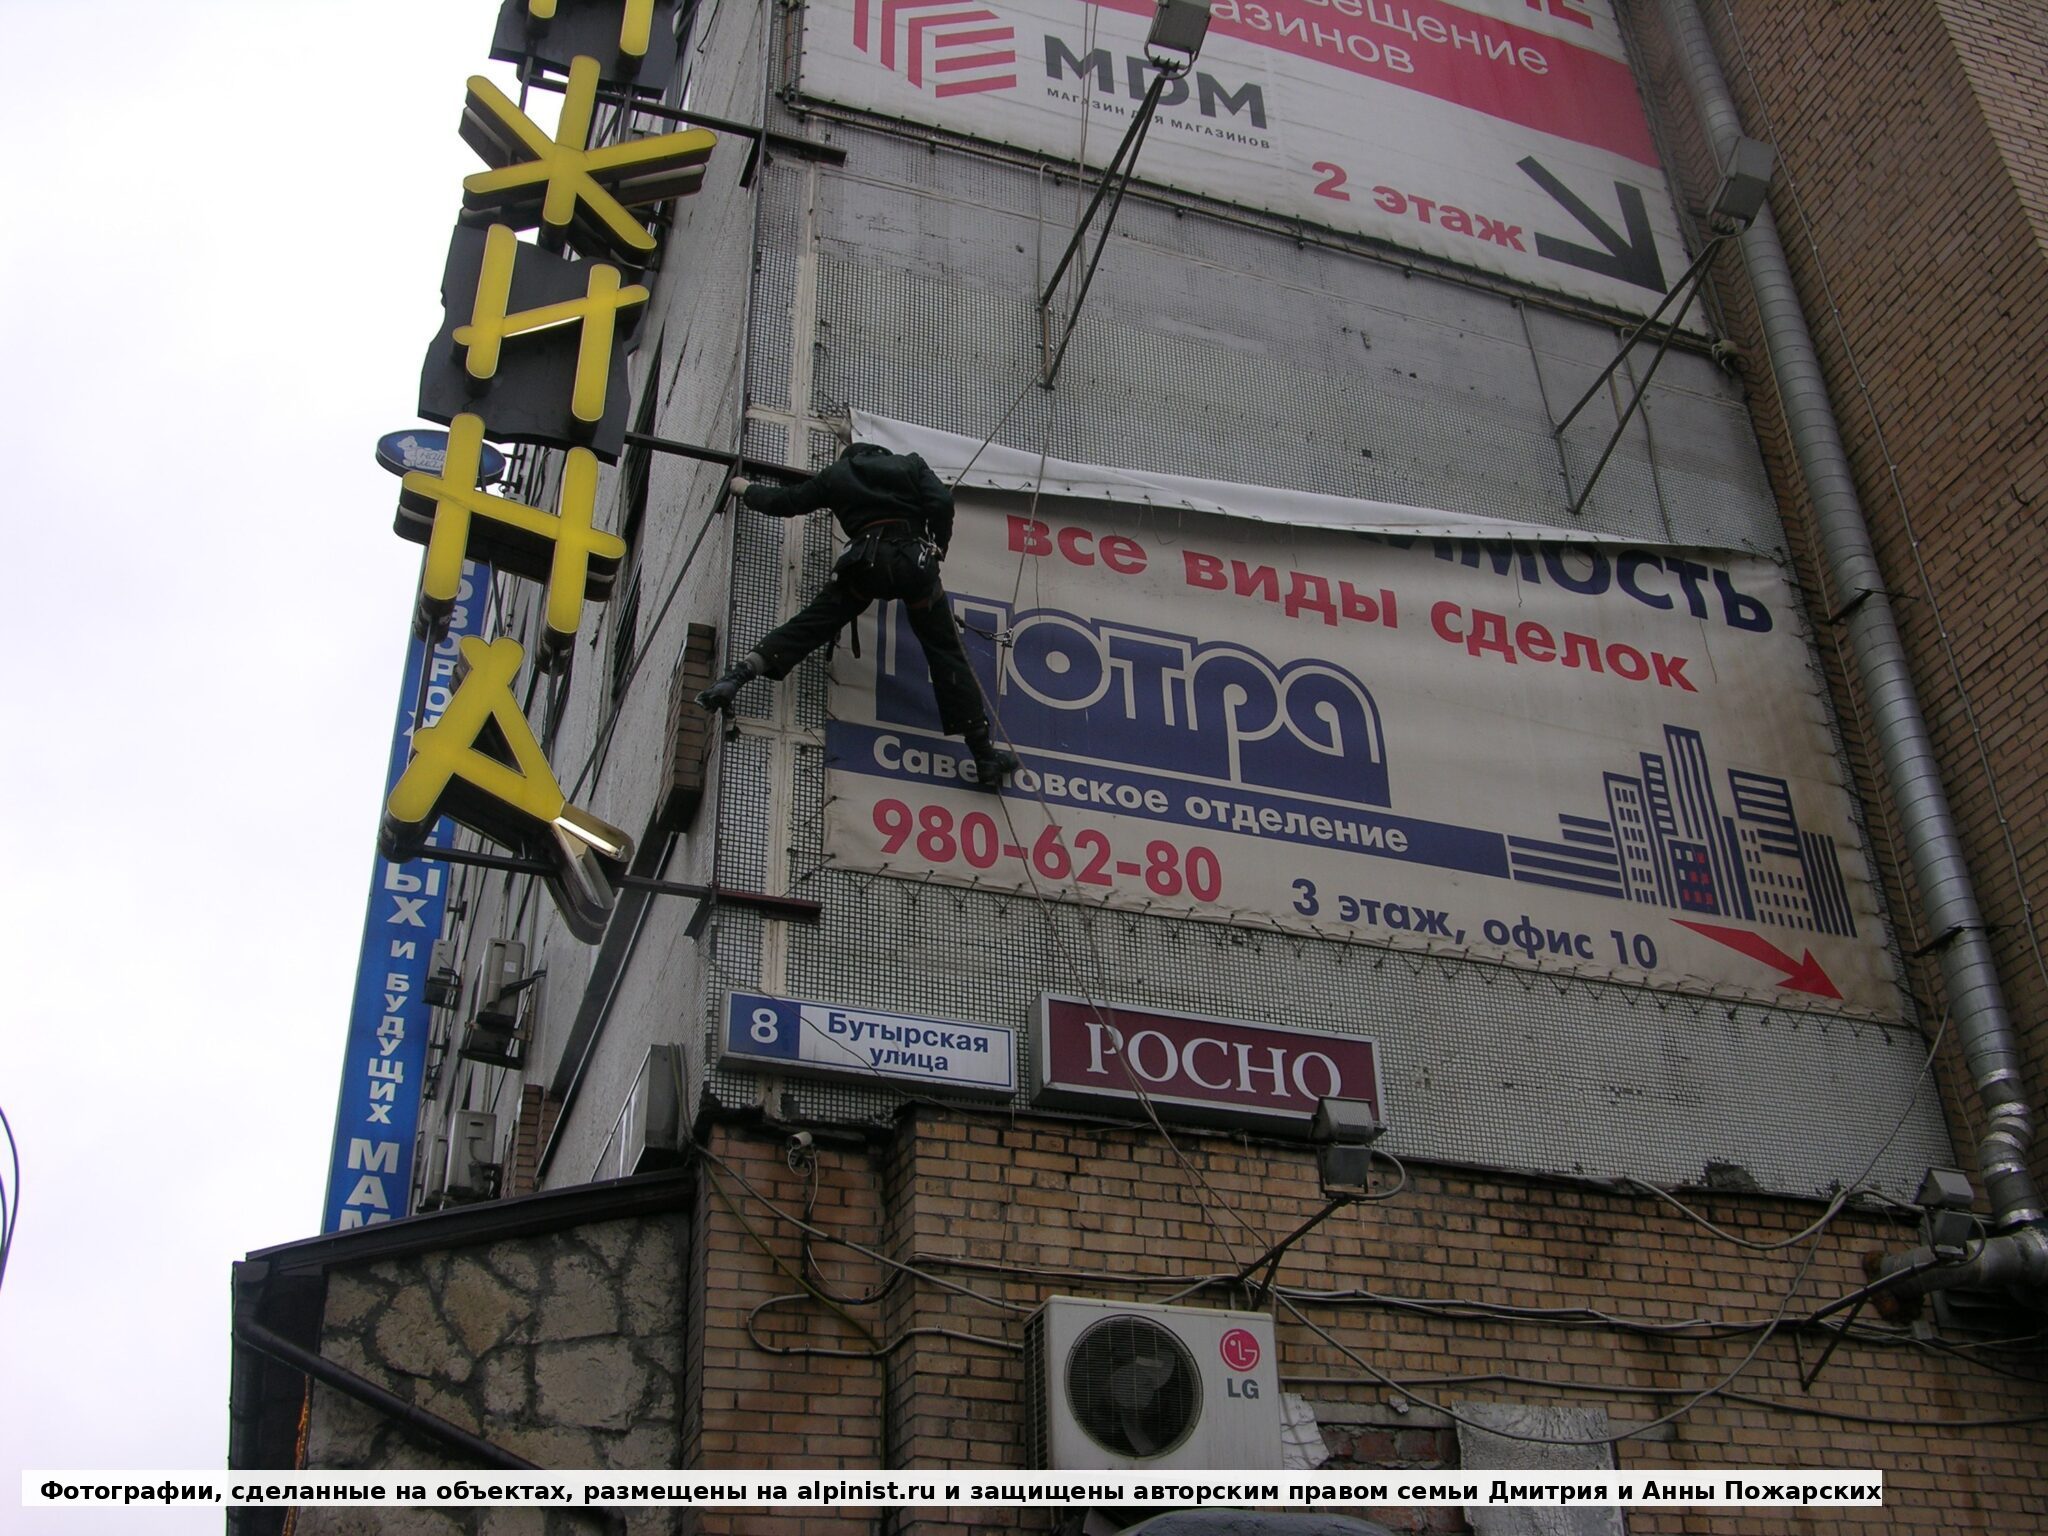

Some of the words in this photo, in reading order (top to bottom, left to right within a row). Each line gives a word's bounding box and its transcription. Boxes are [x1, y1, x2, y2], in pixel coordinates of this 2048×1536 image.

[1210, 0, 1415, 73] азинов
[1047, 88, 1124, 115] МАГАЗИН
[1171, 118, 1270, 150] МАГАЗИНОВ
[1312, 161, 1350, 201] 2
[1372, 186, 1527, 253] этаж
[1007, 514, 1147, 574] все
[1182, 550, 1399, 629] виды
[1430, 600, 1698, 693] сделок
[872, 798, 1222, 902] 980-62-80
[1185, 796, 1409, 853] отделение
[1292, 878, 1320, 916] 3
[1338, 895, 1465, 945] этаж,
[1483, 915, 1594, 960] офис
[1610, 930, 1658, 970] 10
[750, 1008, 779, 1043] 8
[828, 1012, 989, 1053] Бутырская
[869, 1047, 948, 1072] улица
[1084, 1022, 1342, 1101] РОСНО
[1226, 1377, 1259, 1399] LG
